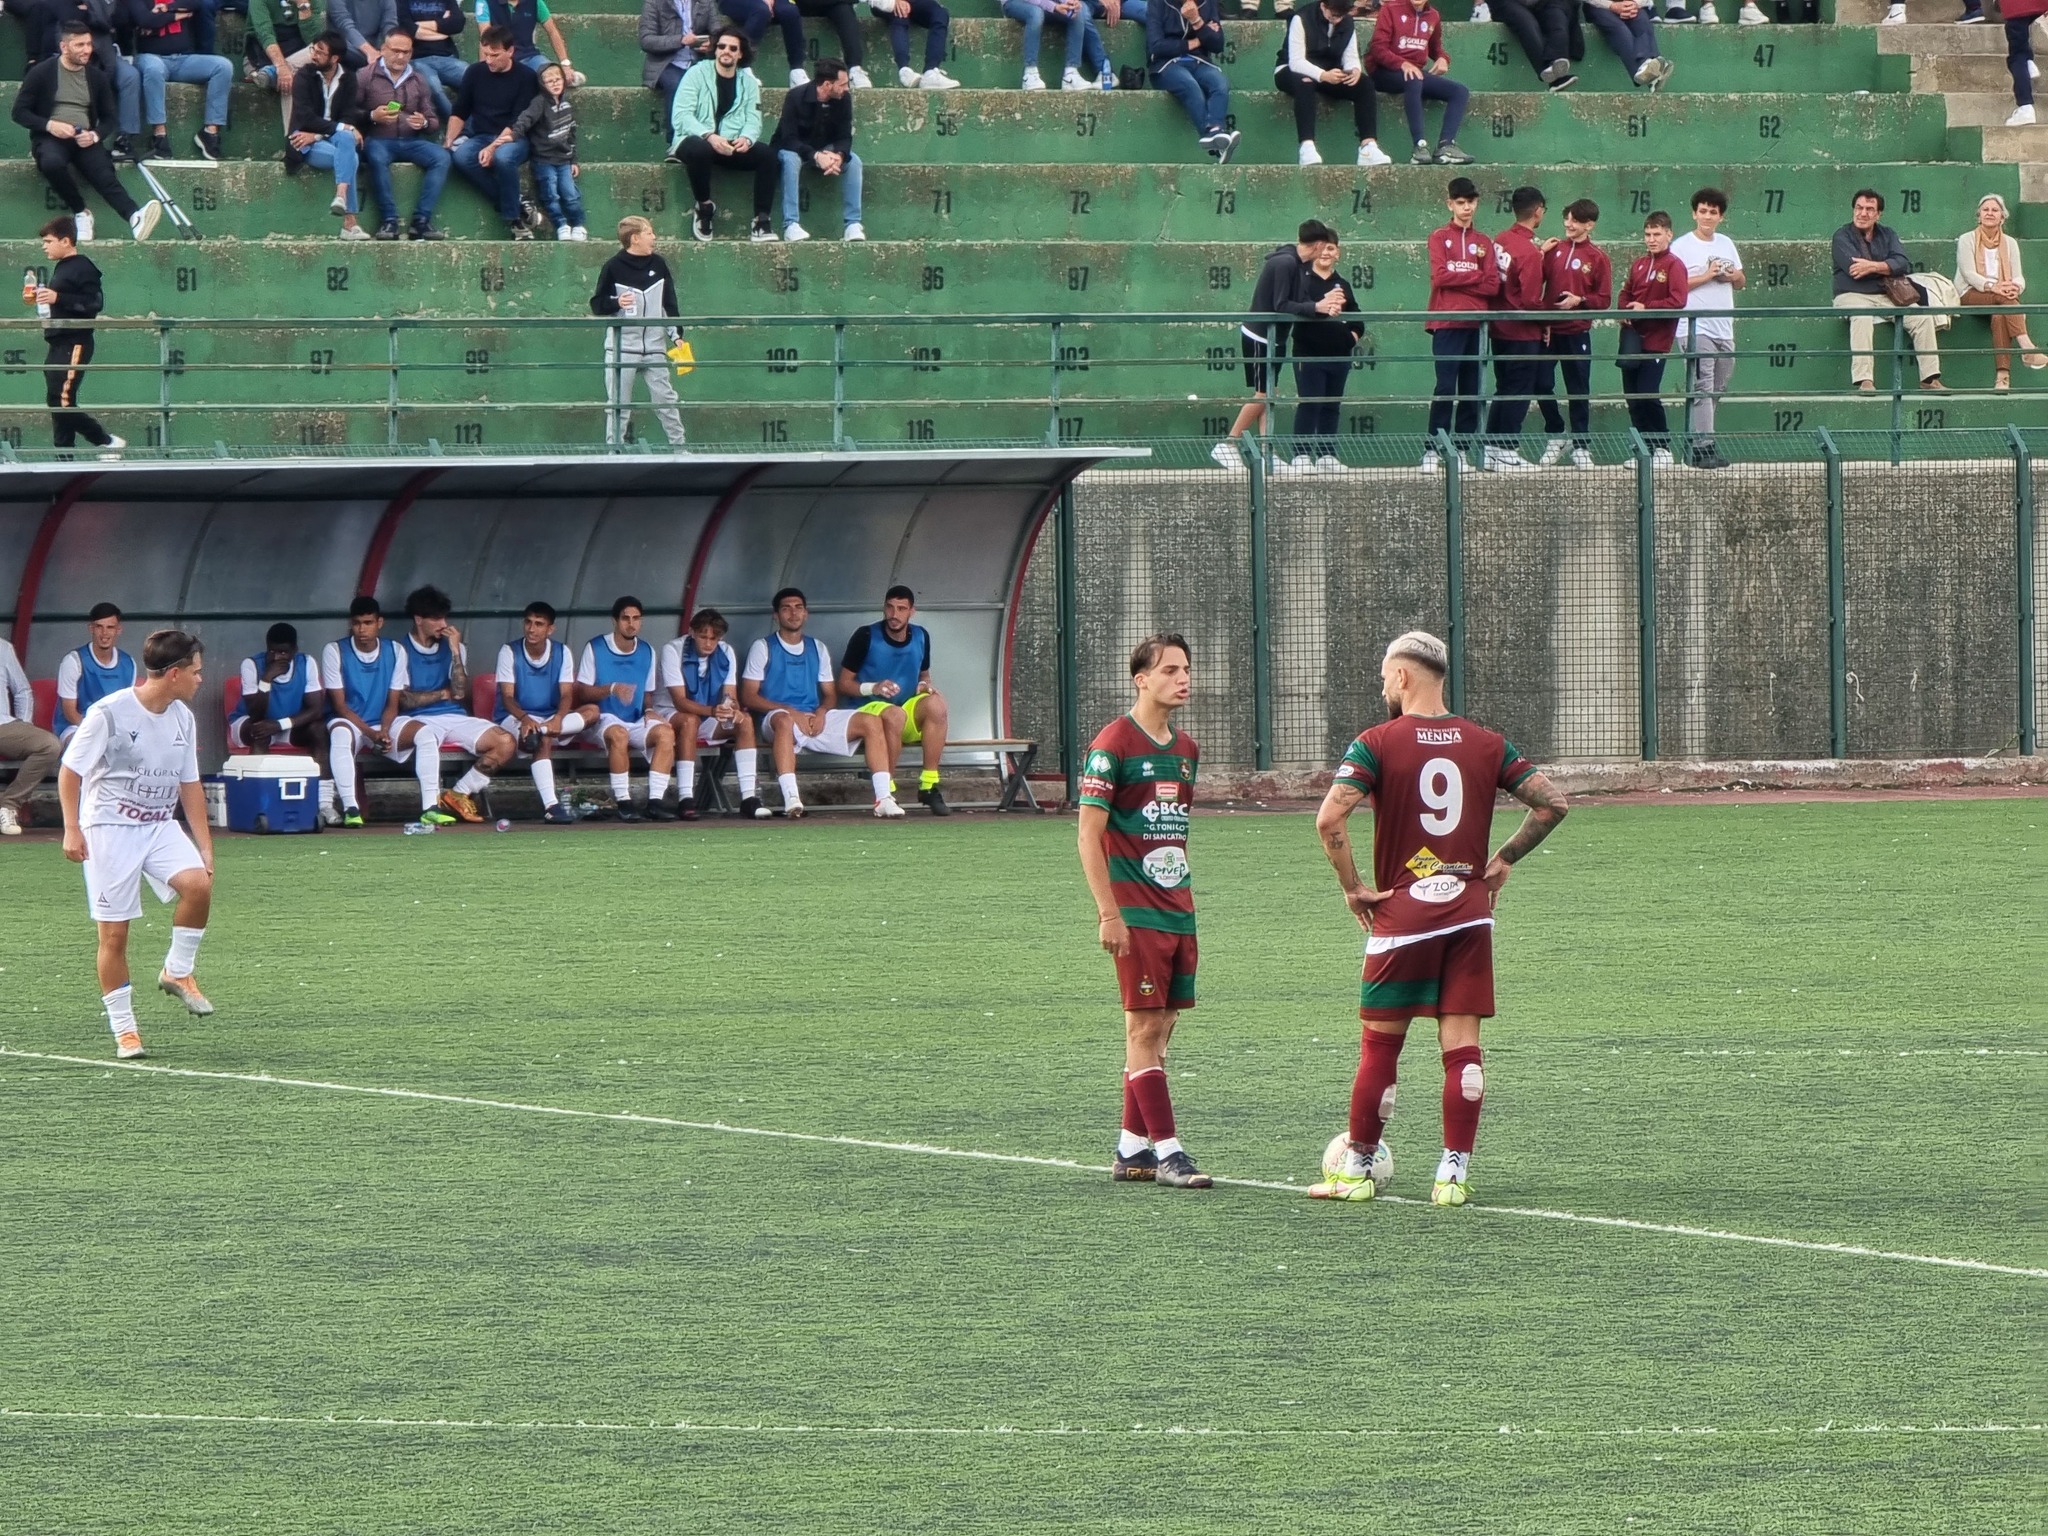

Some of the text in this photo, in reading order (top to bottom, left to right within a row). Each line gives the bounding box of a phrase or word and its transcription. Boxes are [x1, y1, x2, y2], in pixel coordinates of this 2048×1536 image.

[1488, 43, 1508, 65] 45
[1753, 44, 1775, 67] 47
[1076, 113, 1098, 136] 57
[1492, 115, 1514, 138] 60
[1628, 115, 1647, 137] 61
[1760, 116, 1781, 138] 62
[932, 190, 951, 213] 71
[1070, 190, 1090, 214] 72
[1215, 190, 1235, 214] 73
[1352, 189, 1371, 214] 74
[1495, 190, 1514, 213] 75
[1630, 190, 1651, 213] 76
[1765, 190, 1784, 213] 77
[1900, 190, 1921, 213] 78
[176, 267, 197, 291] 81
[327, 267, 349, 291] 82
[1068, 266, 1090, 291] 87
[1767, 263, 1789, 287] 92
[766, 348, 798, 373] 100
[1767, 343, 1797, 368] 107
[762, 420, 788, 442] 115
[907, 419, 935, 442] 116
[1058, 418, 1083, 441] 117
[1774, 411, 1803, 432] 122
[1916, 409, 1945, 430] 123
[455, 423, 482, 446] 113
[1417, 731, 1463, 741] MENNA
[1419, 757, 1464, 836] 9
[1160, 802, 1189, 816] BCC
[1143, 833, 1152, 841] DI
